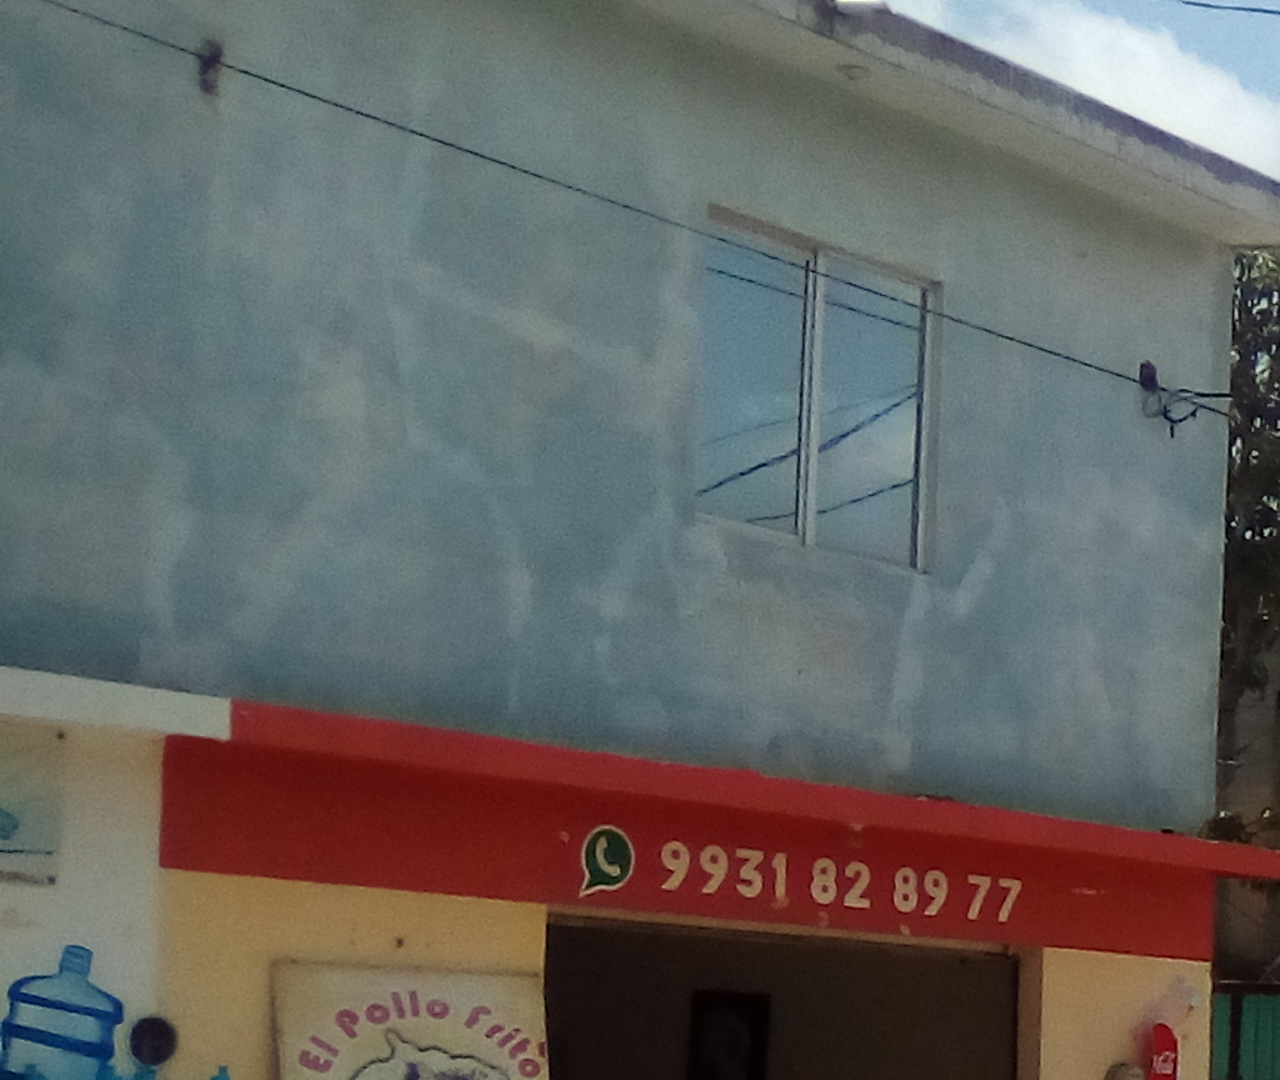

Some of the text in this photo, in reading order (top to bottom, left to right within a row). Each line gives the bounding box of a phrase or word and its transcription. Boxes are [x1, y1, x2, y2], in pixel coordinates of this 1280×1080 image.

[660, 840, 1023, 923] 9931 82 89 77
[298, 1035, 339, 1074] El
